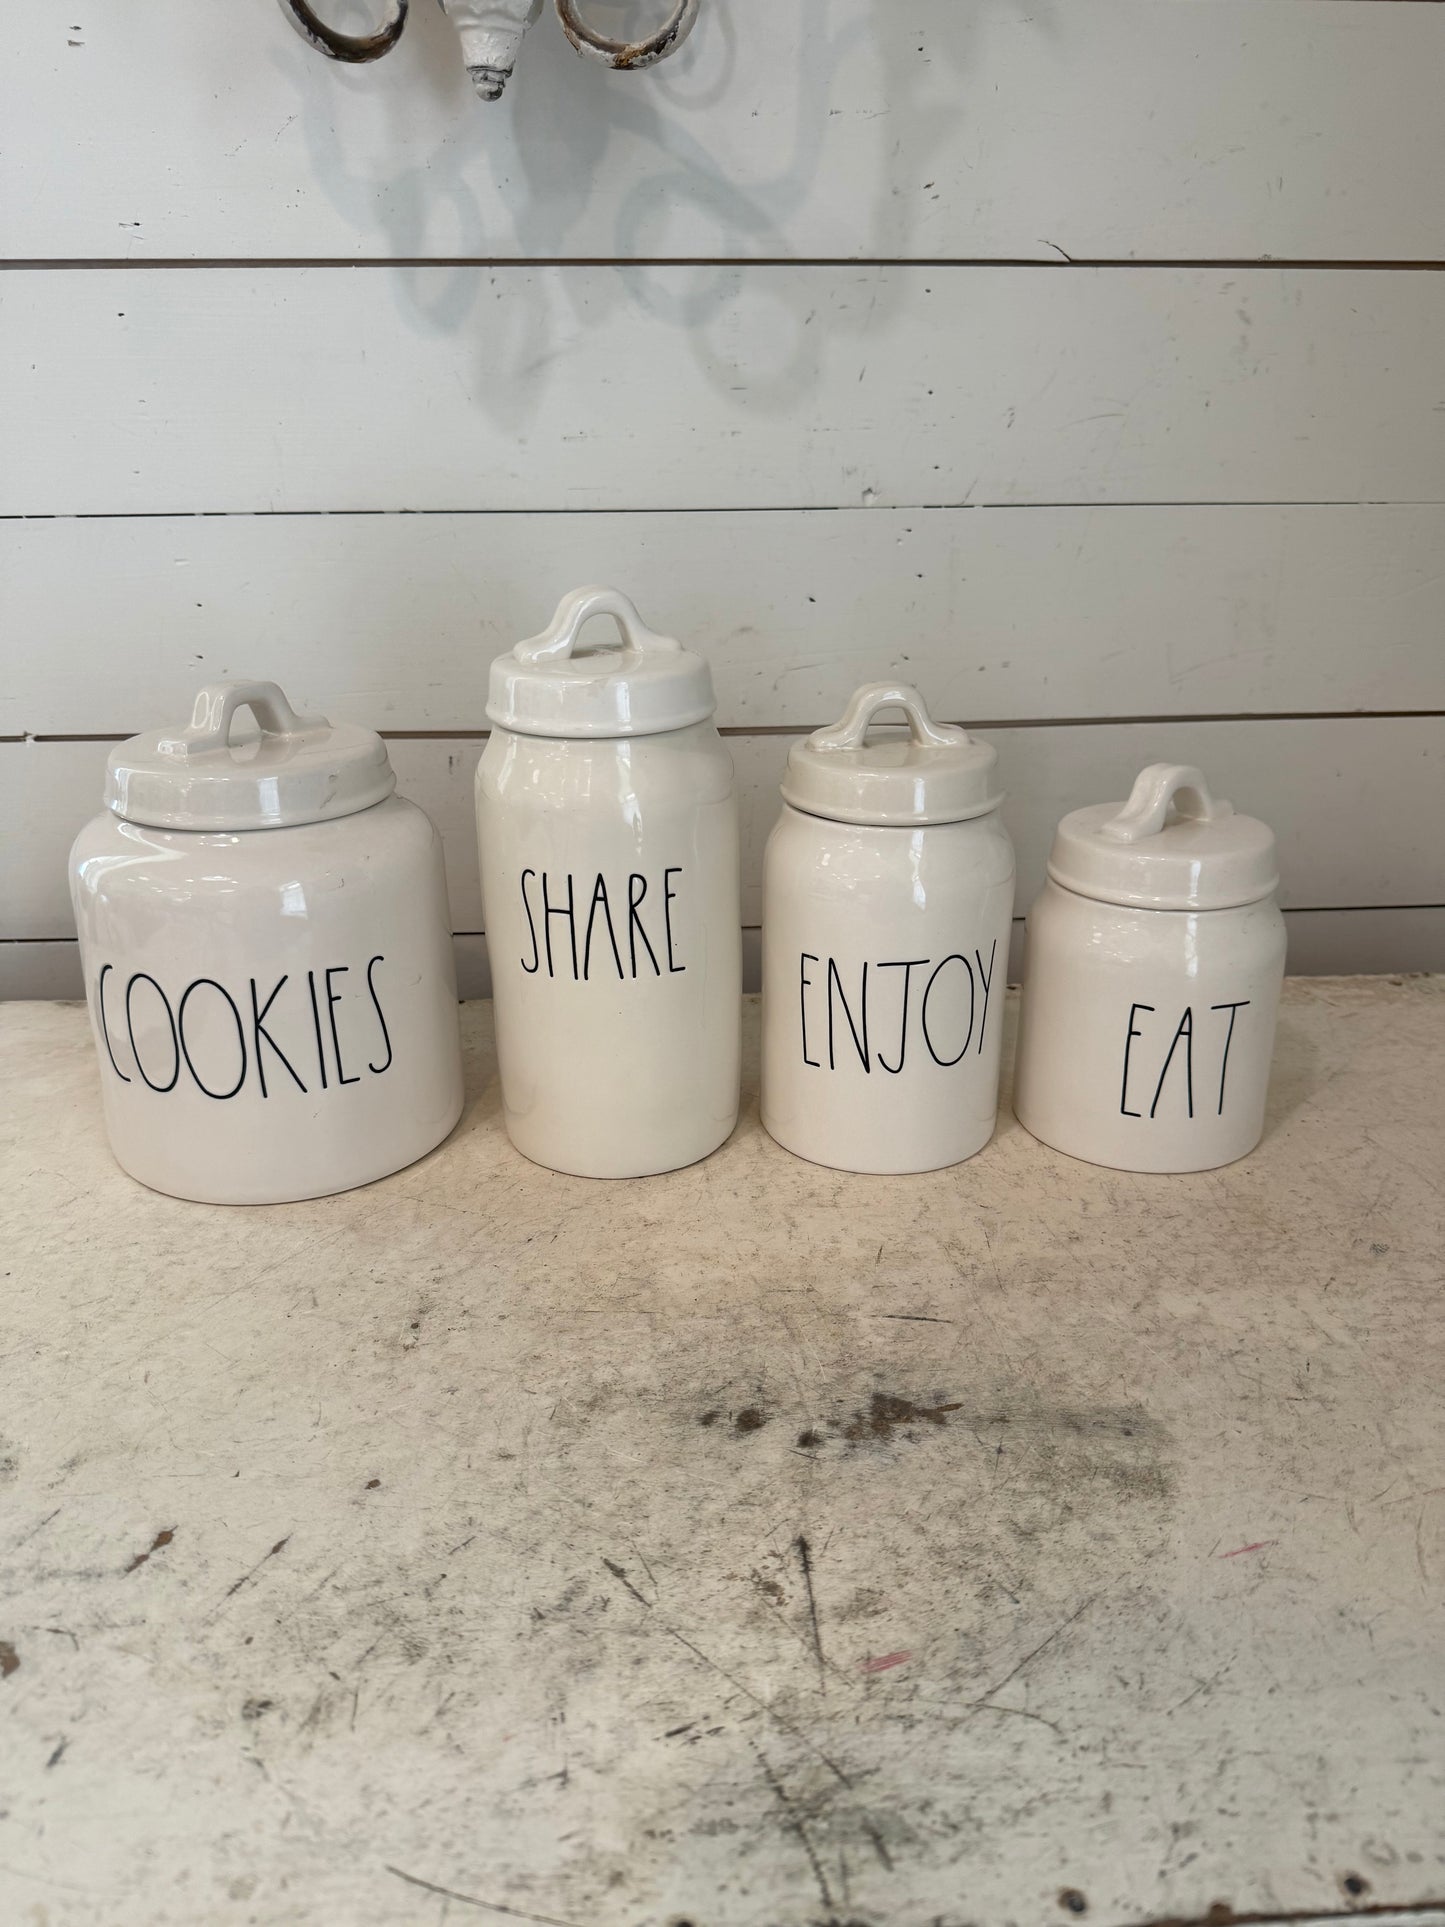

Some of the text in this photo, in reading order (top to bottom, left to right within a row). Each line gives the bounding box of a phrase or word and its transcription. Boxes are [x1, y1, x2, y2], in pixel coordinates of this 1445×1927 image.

[520, 867, 686, 981] SHARE
[99, 955, 393, 1100] COOKIES
[800, 938, 997, 1074] ENJOY
[1120, 1000, 1251, 1119] EAT
